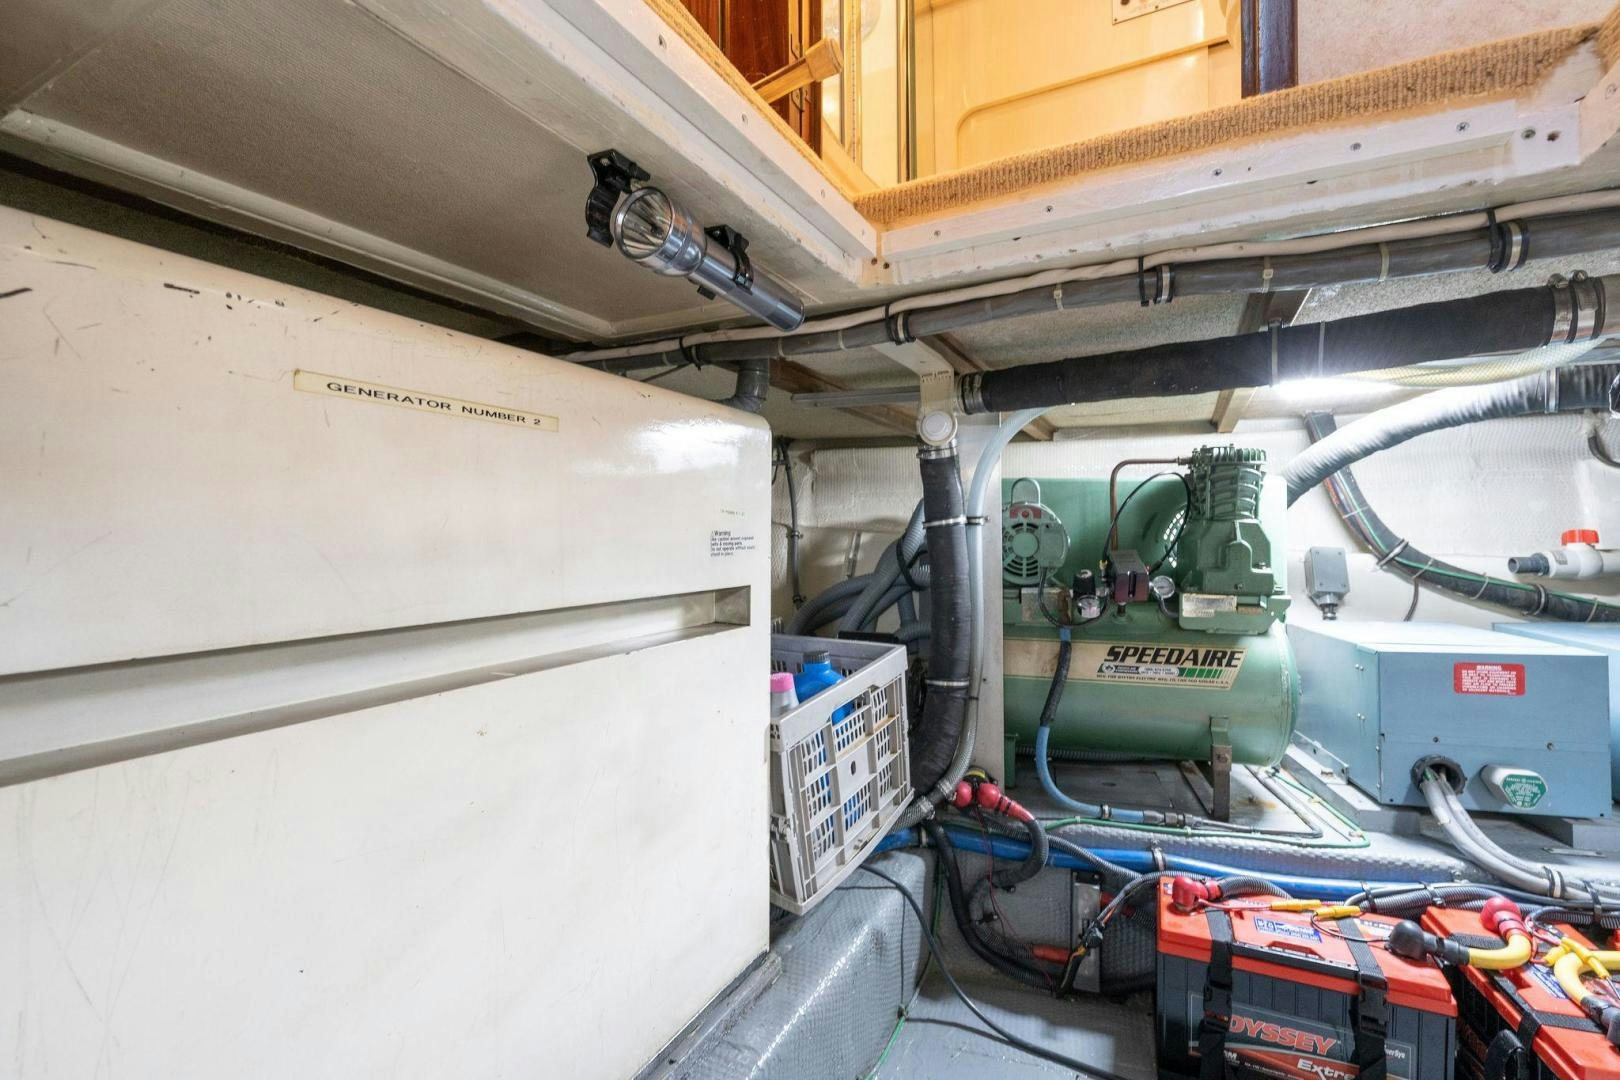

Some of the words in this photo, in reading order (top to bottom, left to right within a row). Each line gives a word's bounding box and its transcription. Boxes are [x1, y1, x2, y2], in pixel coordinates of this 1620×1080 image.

[326, 382, 452, 411] GENERATOR
[461, 405, 527, 424] NUMBER
[533, 418, 541, 426] 2
[1103, 645, 1244, 668] SPEEDAIRE
[1228, 1013, 1337, 1056] DYSSEY
